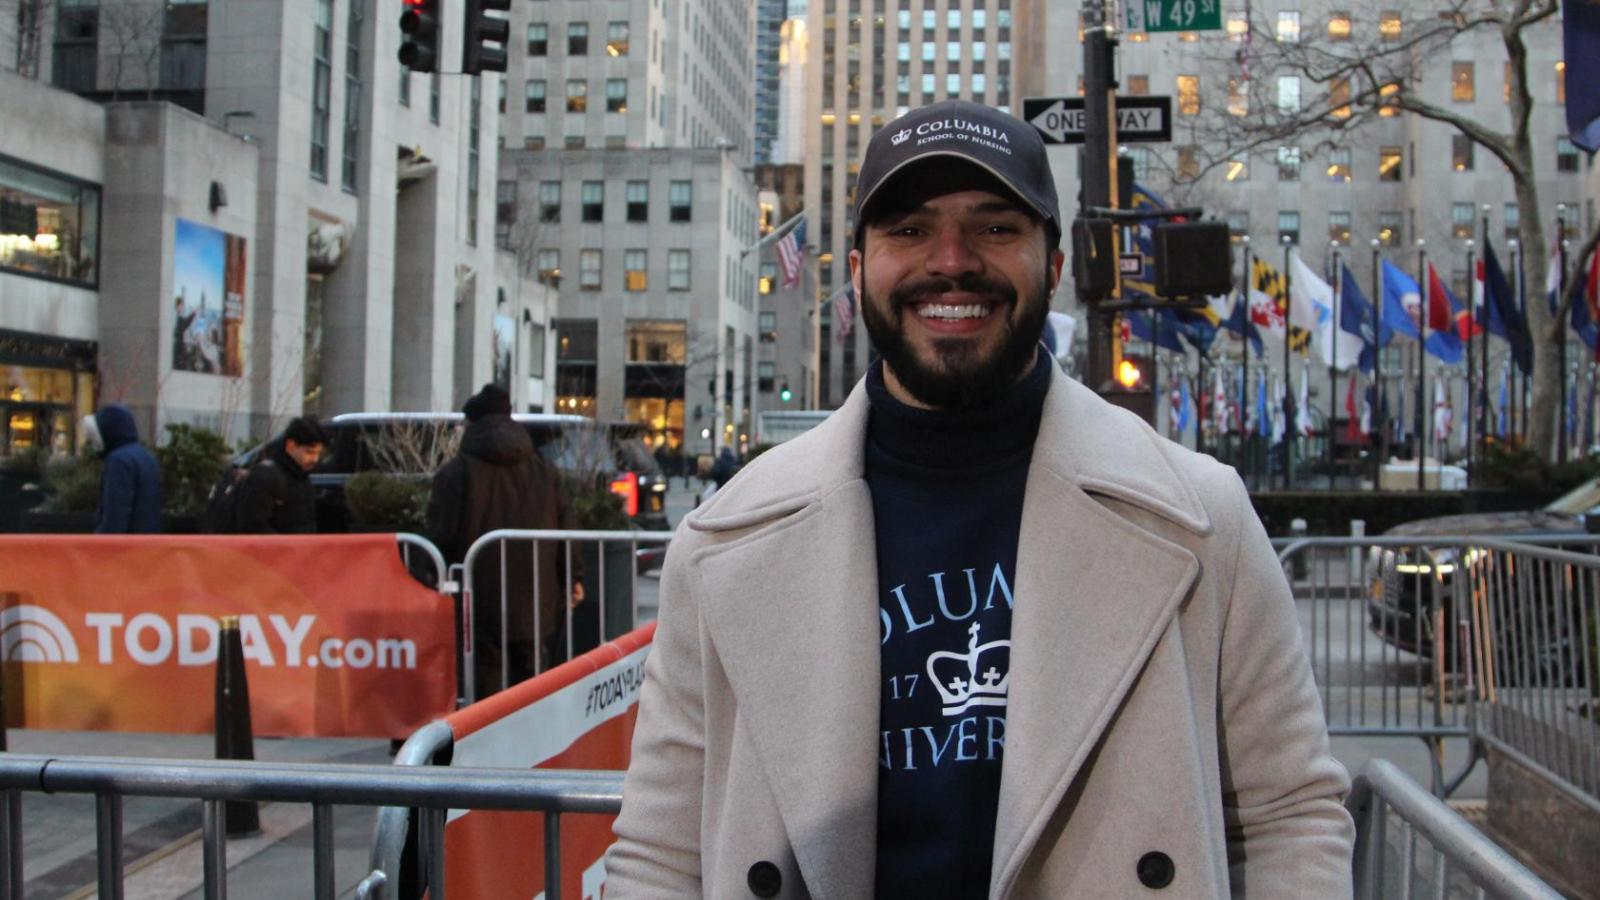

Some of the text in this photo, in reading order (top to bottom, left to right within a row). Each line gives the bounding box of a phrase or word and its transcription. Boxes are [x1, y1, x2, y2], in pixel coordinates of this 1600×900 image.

[1146, 0, 1162, 27] W
[1169, 0, 1196, 27] 49
[916, 119, 1009, 143] COLUMBIA
[1046, 111, 1152, 131] ONE AY
[917, 132, 1012, 155] SCHOOL OF NURSING
[85, 612, 418, 670] TODAY.com
[889, 674, 919, 700] 17
